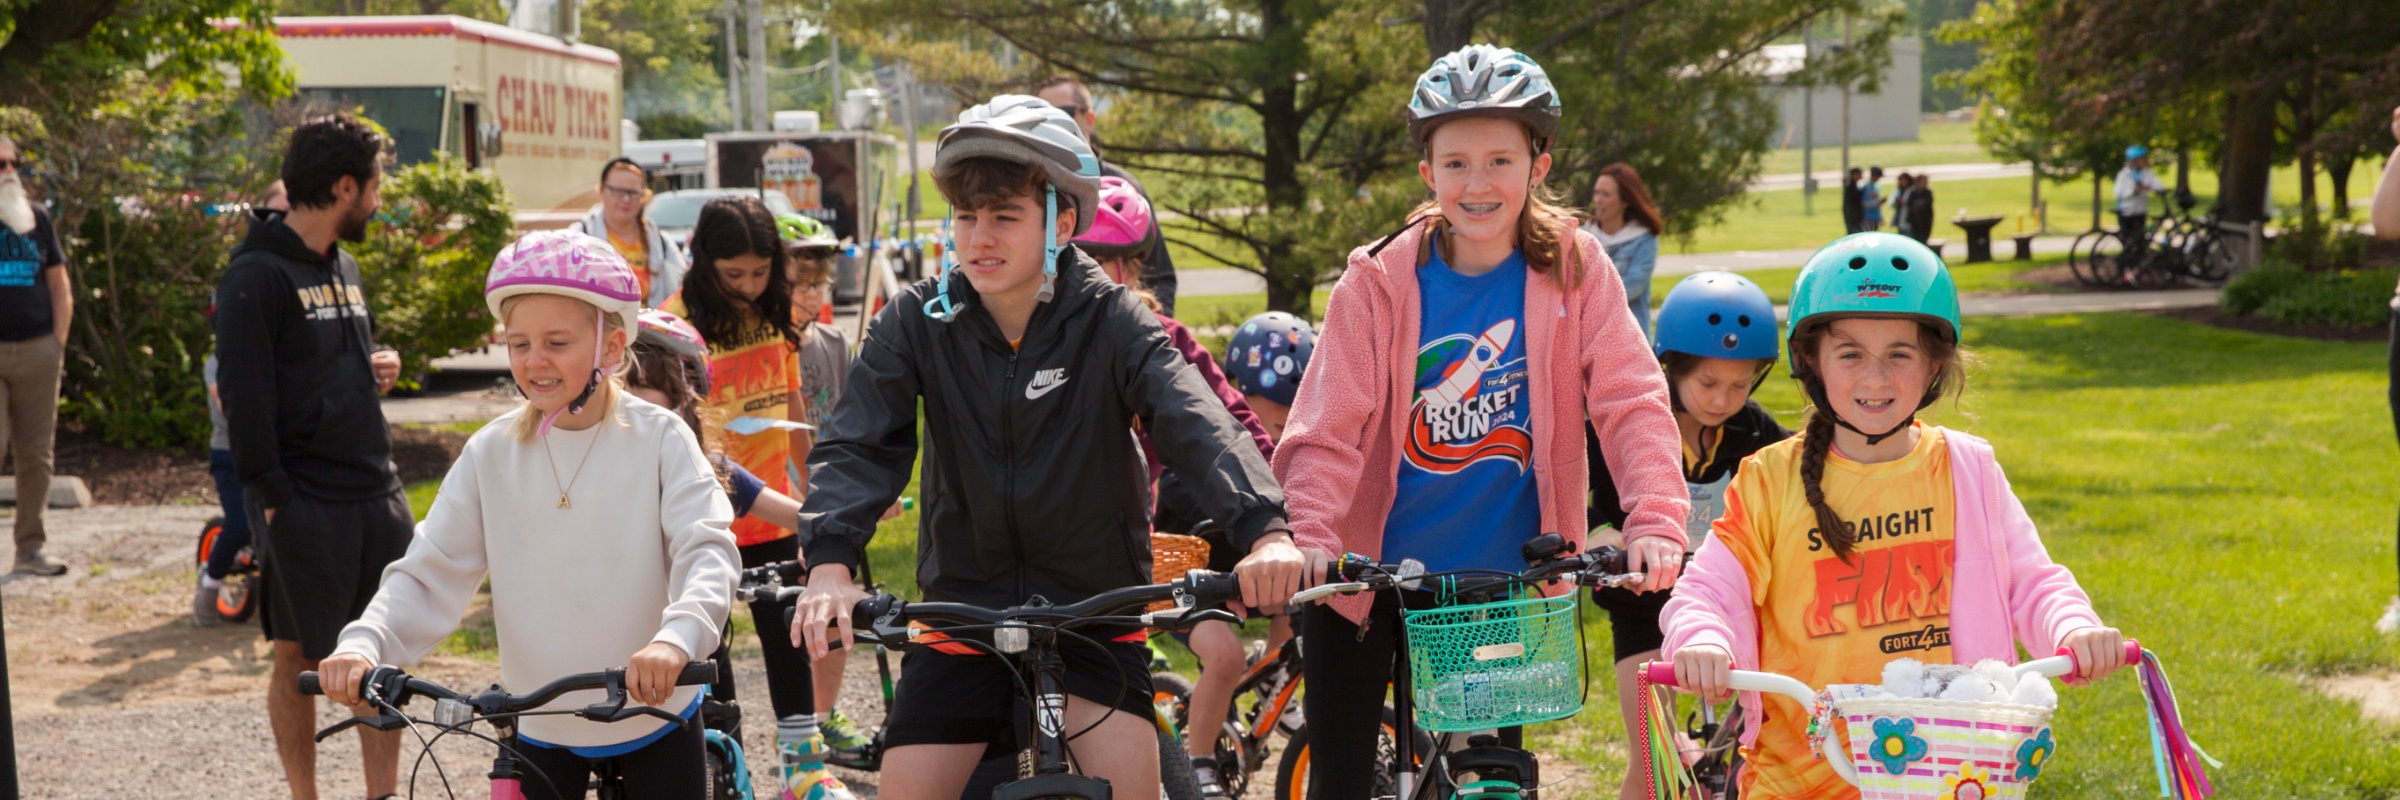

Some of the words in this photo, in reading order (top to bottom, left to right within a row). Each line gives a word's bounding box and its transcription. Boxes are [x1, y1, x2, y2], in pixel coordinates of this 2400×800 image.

[496, 75, 557, 136] CHAU
[564, 84, 609, 140] TIME
[1032, 367, 1065, 387] NIKE
[1425, 384, 1521, 424] ROCKET
[1491, 410, 1516, 427] 2024
[1432, 412, 1490, 443] RUN
[1807, 507, 1934, 552] SAIGHT
